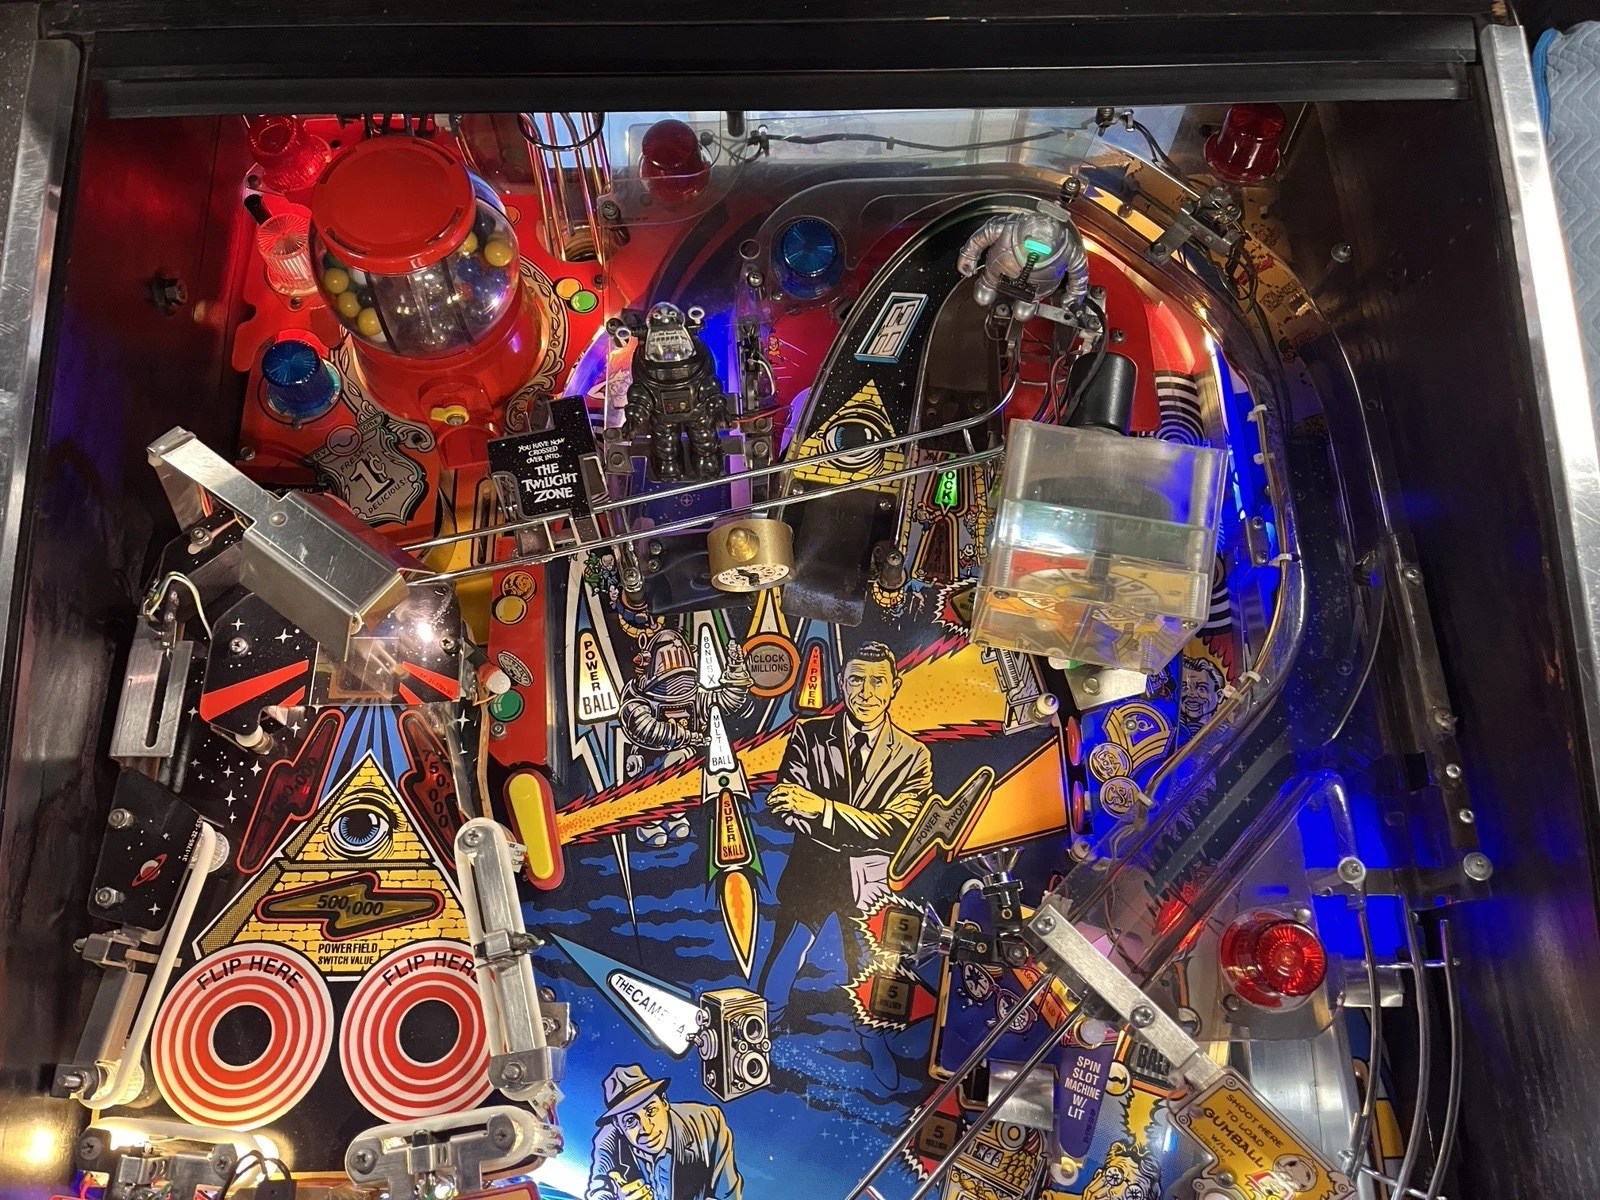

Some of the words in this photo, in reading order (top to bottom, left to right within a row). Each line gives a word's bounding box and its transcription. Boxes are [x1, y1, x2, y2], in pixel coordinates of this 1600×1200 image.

[518, 444, 532, 453] YOU
[532, 440, 549, 450] HAVE
[550, 437, 565, 445] NOW
[528, 445, 558, 457] CROSSED
[526, 455, 544, 464] OVER
[534, 462, 559, 476] THE
[521, 472, 578, 492] TWILIGHT
[941, 469, 956, 501] OCK
[368, 476, 408, 513] DELICIOUS!
[533, 486, 574, 503] ZONE
[703, 636, 714, 673] BONUS
[753, 654, 785, 664] CLOCK
[584, 640, 601, 692] POWER
[751, 663, 789, 673] MILLIONS
[707, 674, 716, 685] X
[808, 668, 818, 706] POWER
[582, 691, 617, 715] BALL
[712, 714, 723, 753] MULTI
[712, 755, 732, 767] BALL
[724, 800, 736, 842] SUPER
[944, 797, 969, 831] PAYOFF
[916, 811, 941, 845] POWER
[723, 844, 744, 858] SKILL
[317, 894, 384, 916] 500,000
[898, 918, 909, 932] 5
[318, 955, 348, 965] SWITCH
[350, 955, 374, 965] VALUE
[382, 954, 426, 987] FLIP
[196, 957, 242, 991] FLIP
[248, 955, 304, 989] HERE
[887, 985, 899, 999] 5
[615, 975, 635, 996] THE
[631, 988, 686, 1038] CAMA
[1076, 1055, 1102, 1074] SPIN
[1072, 1067, 1100, 1086] SLOT
[1064, 1077, 1101, 1101] MACHINE
[1072, 1093, 1088, 1109] W/
[1067, 1105, 1085, 1121] LIT
[1226, 1093, 1259, 1125] SHOOT
[1257, 1121, 1285, 1149] HERE
[932, 1124, 945, 1140] 5
[1203, 1106, 1265, 1169] GUMBALL
[1225, 1109, 1239, 1123] TO
[1238, 1121, 1265, 1148] LOAD
[1211, 1133, 1236, 1158] W/LIT
